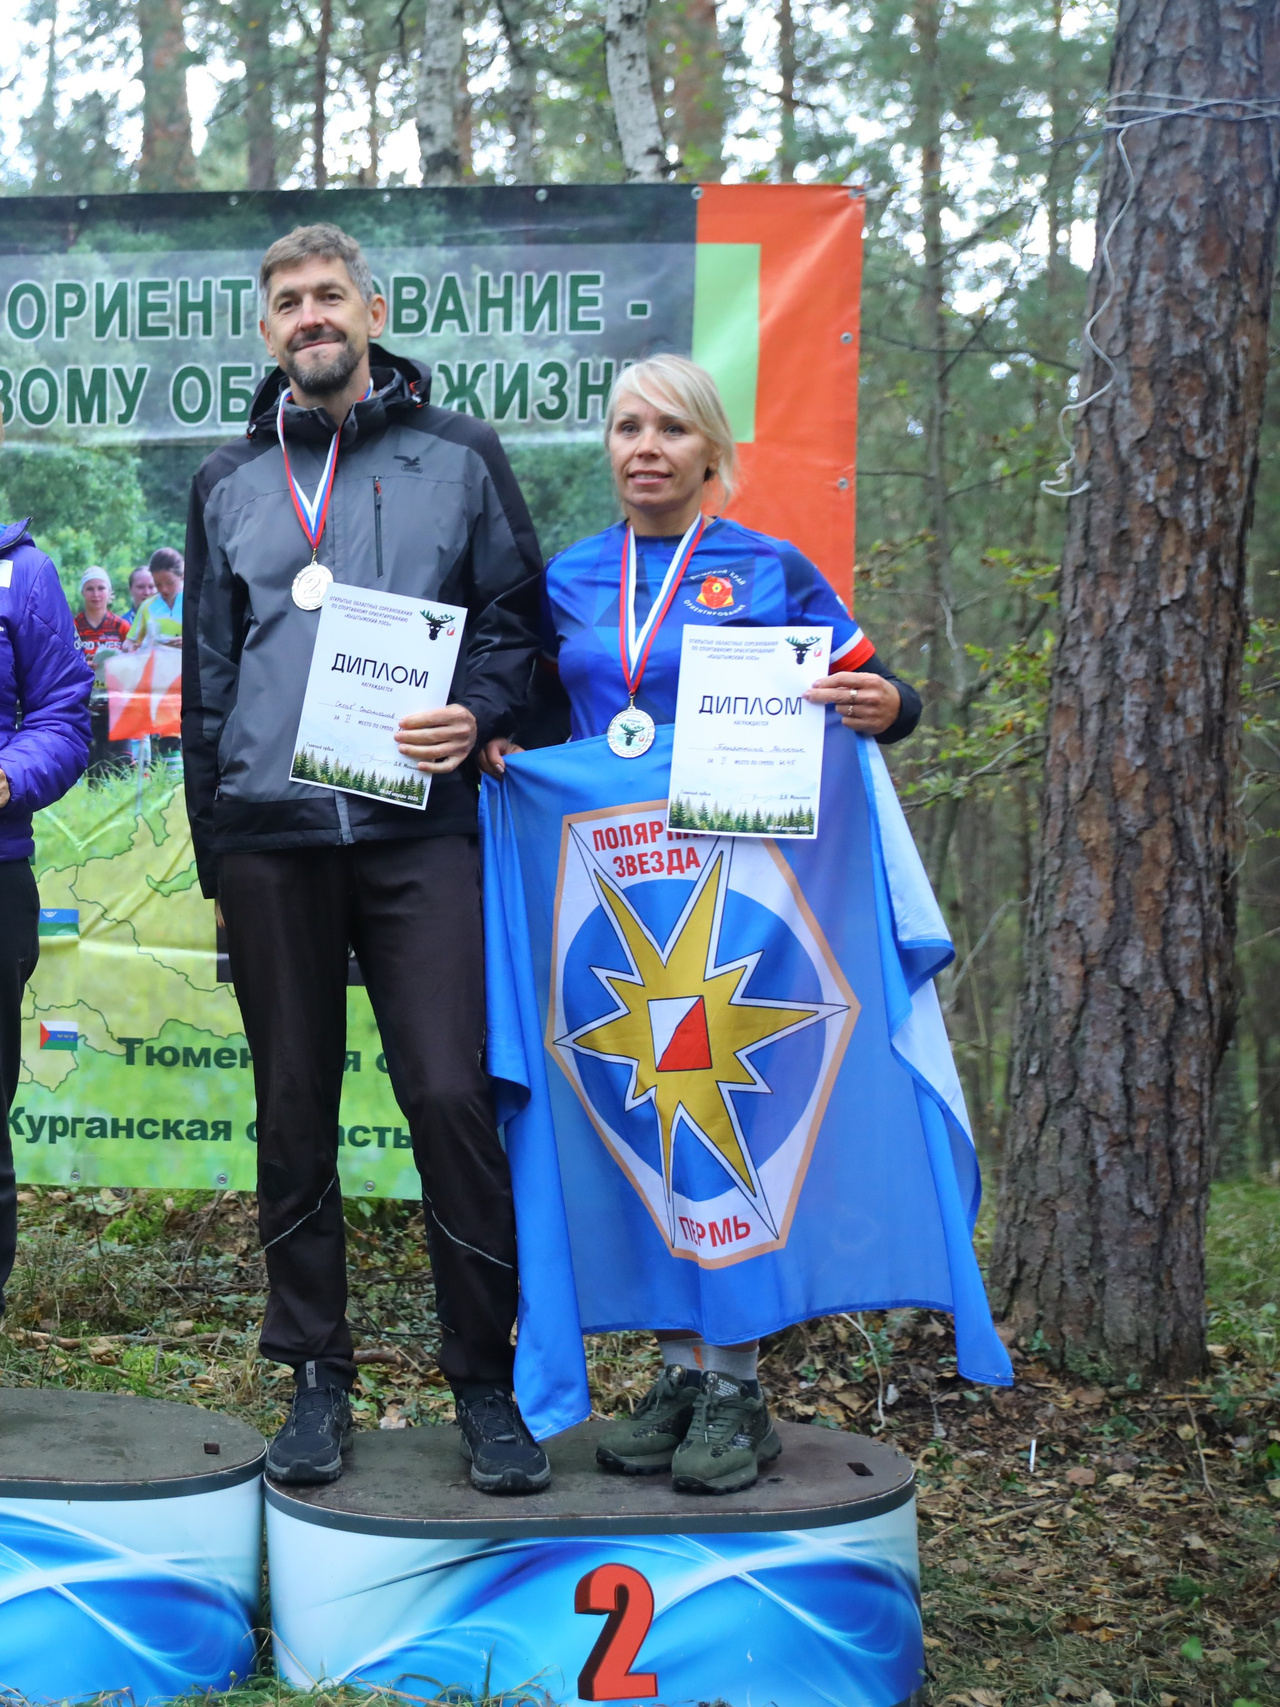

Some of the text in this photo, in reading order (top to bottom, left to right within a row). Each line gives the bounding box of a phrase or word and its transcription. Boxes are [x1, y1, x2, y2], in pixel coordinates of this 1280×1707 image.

[6, 271, 604, 342] ОРИЕНТВАНИЕ
[434, 359, 635, 424] ЖИЗН
[331, 653, 428, 688] ДИПЛОМ
[699, 695, 802, 715] ДИПЛОМ
[612, 846, 701, 879] ЗВЕЗДА
[7, 1105, 232, 1145] Курганская
[678, 1215, 751, 1248] ПЕРМЬ
[574, 1562, 658, 1702] 2
